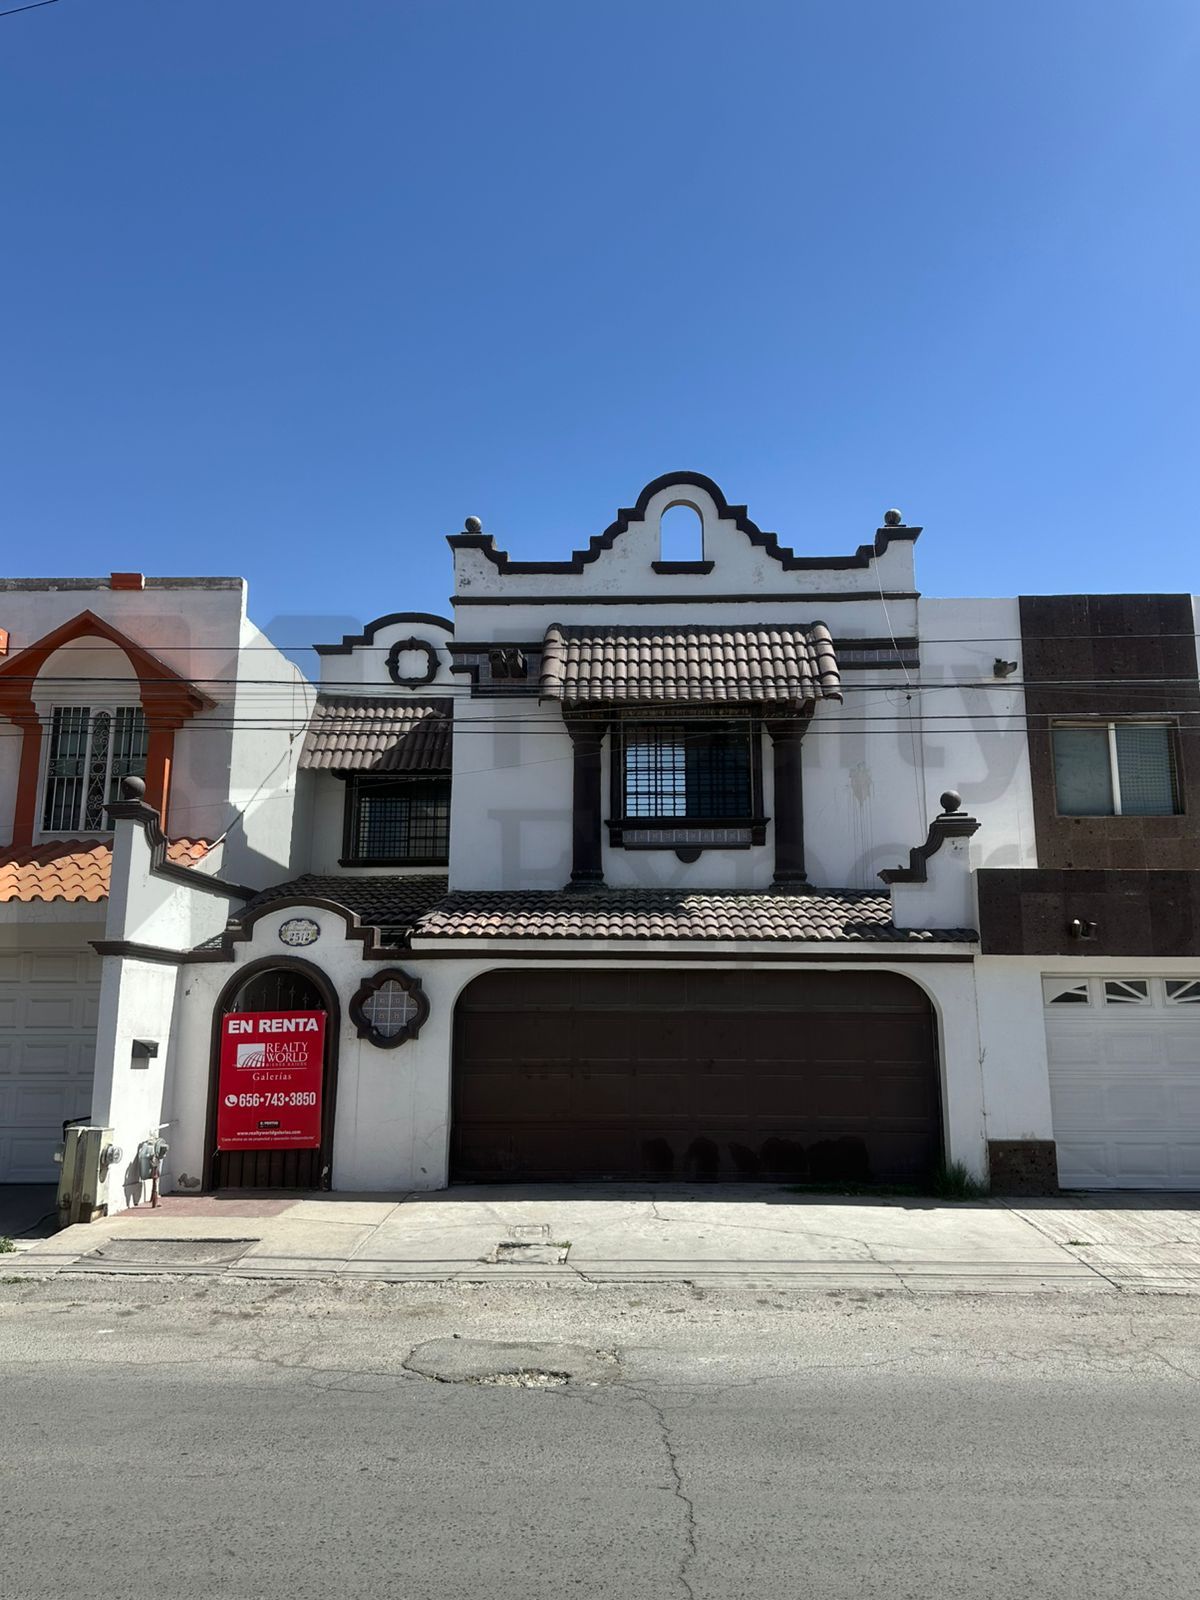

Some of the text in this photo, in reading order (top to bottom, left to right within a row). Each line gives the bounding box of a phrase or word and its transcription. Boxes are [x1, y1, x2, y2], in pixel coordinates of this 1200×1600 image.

[289, 931, 309, 941] 2512
[228, 1017, 319, 1034] EN RENTA
[266, 1041, 308, 1053] REALTY
[266, 1051, 308, 1063] WORLD
[252, 1071, 292, 1081] Galerías
